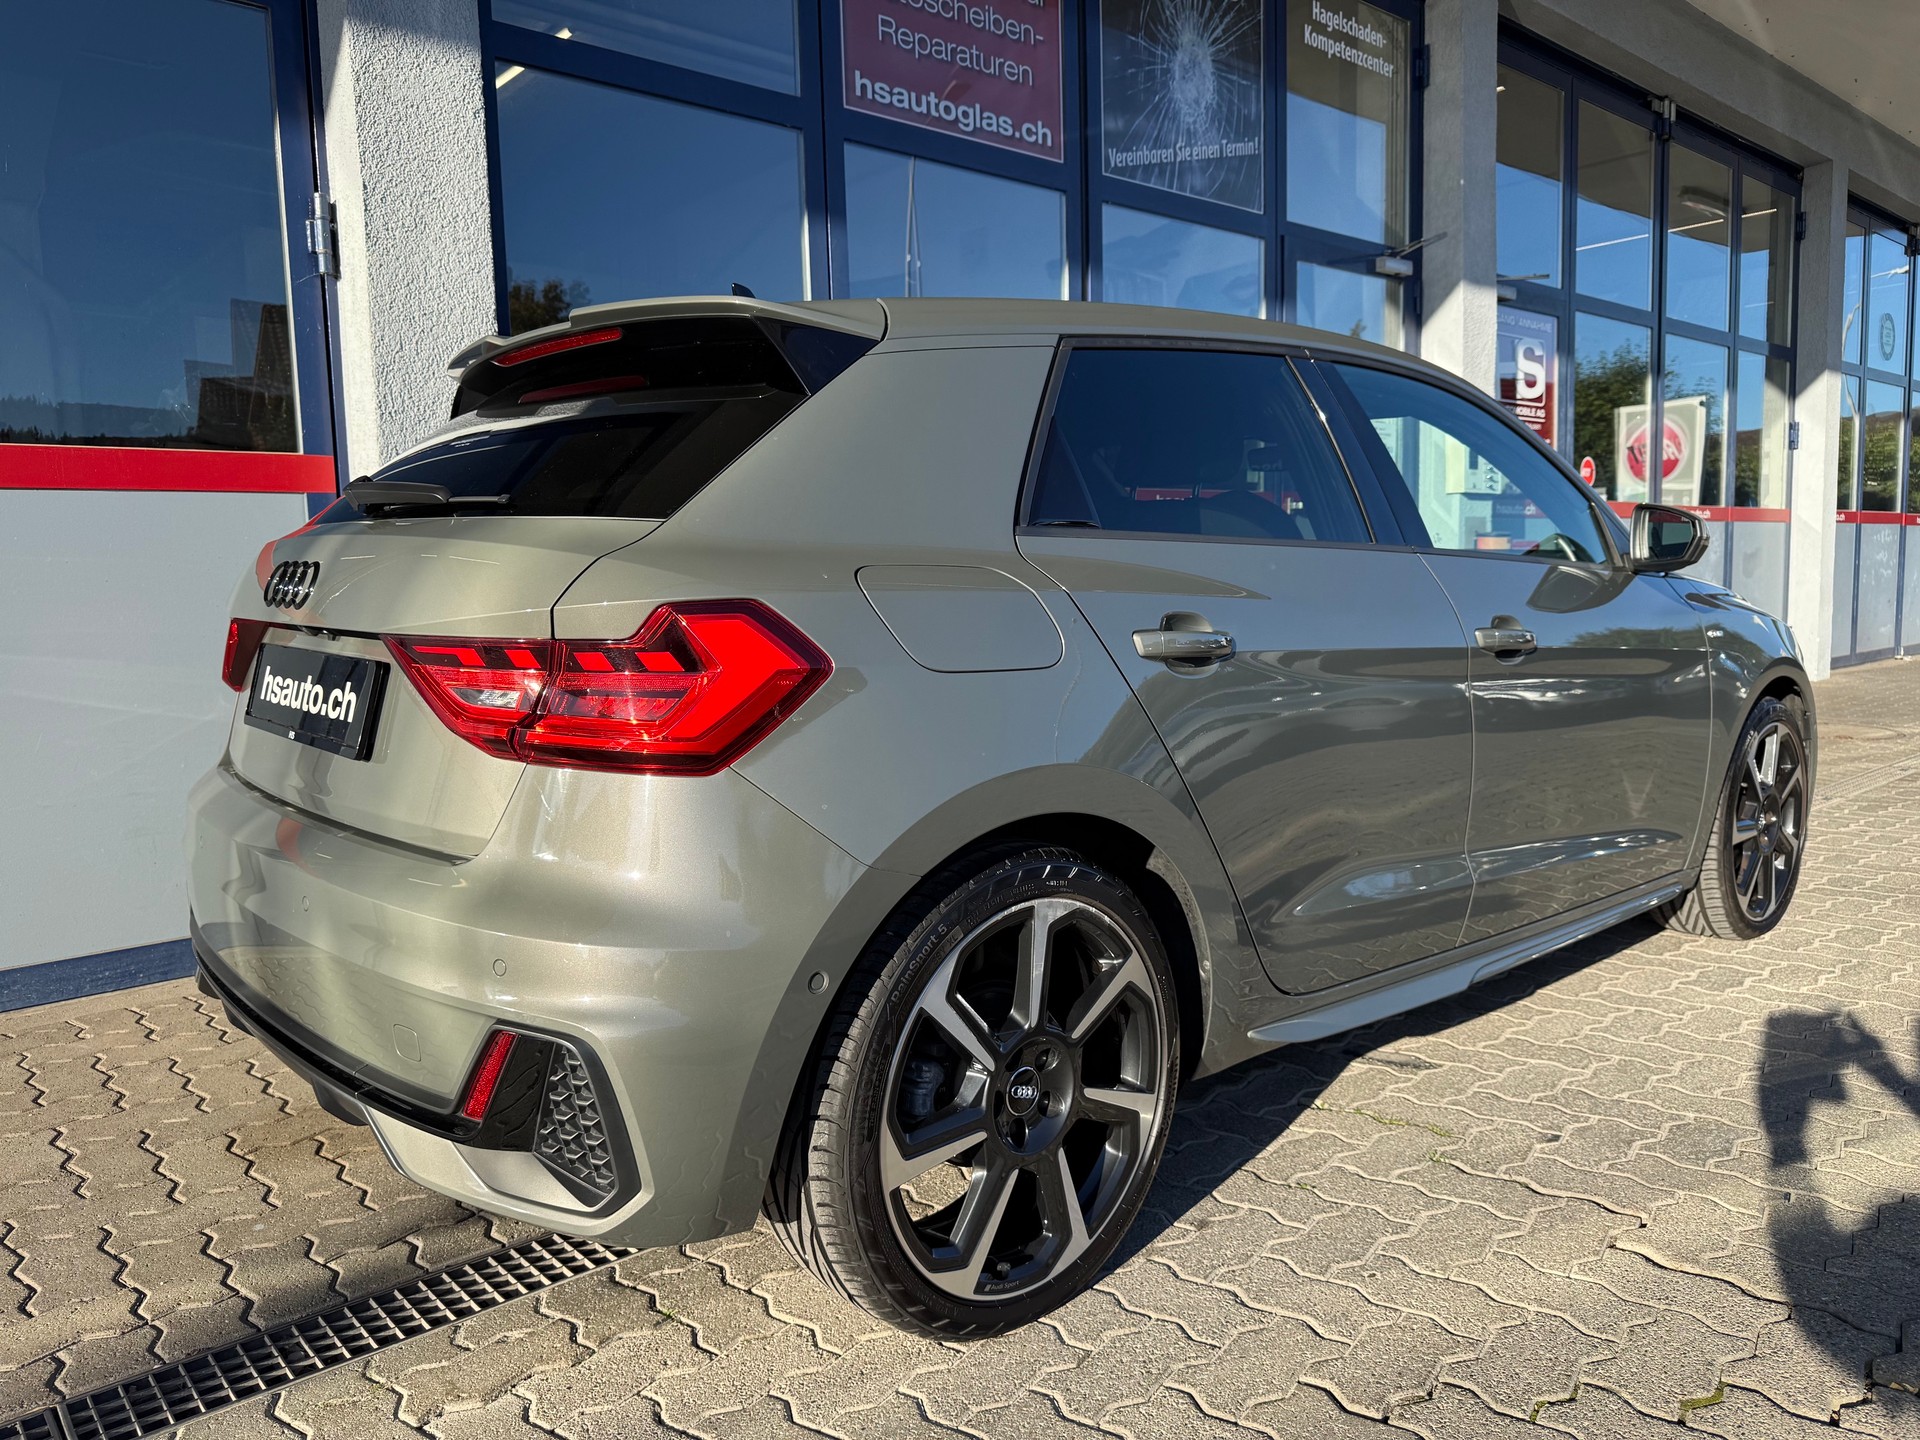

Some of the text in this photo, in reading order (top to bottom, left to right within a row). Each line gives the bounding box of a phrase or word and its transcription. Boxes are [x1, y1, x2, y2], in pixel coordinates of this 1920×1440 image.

[901, 0, 1044, 45] scheiben-
[1312, 0, 1387, 48] Hagelschaden-
[878, 14, 1033, 86] Reparaturen
[1304, 24, 1394, 78] Kompetenzcenter
[855, 70, 1052, 147] hsautoglas.ch
[1108, 137, 1259, 168] Vereinbaren Sie einen Termin!
[260, 665, 357, 723] hsauto.ch
